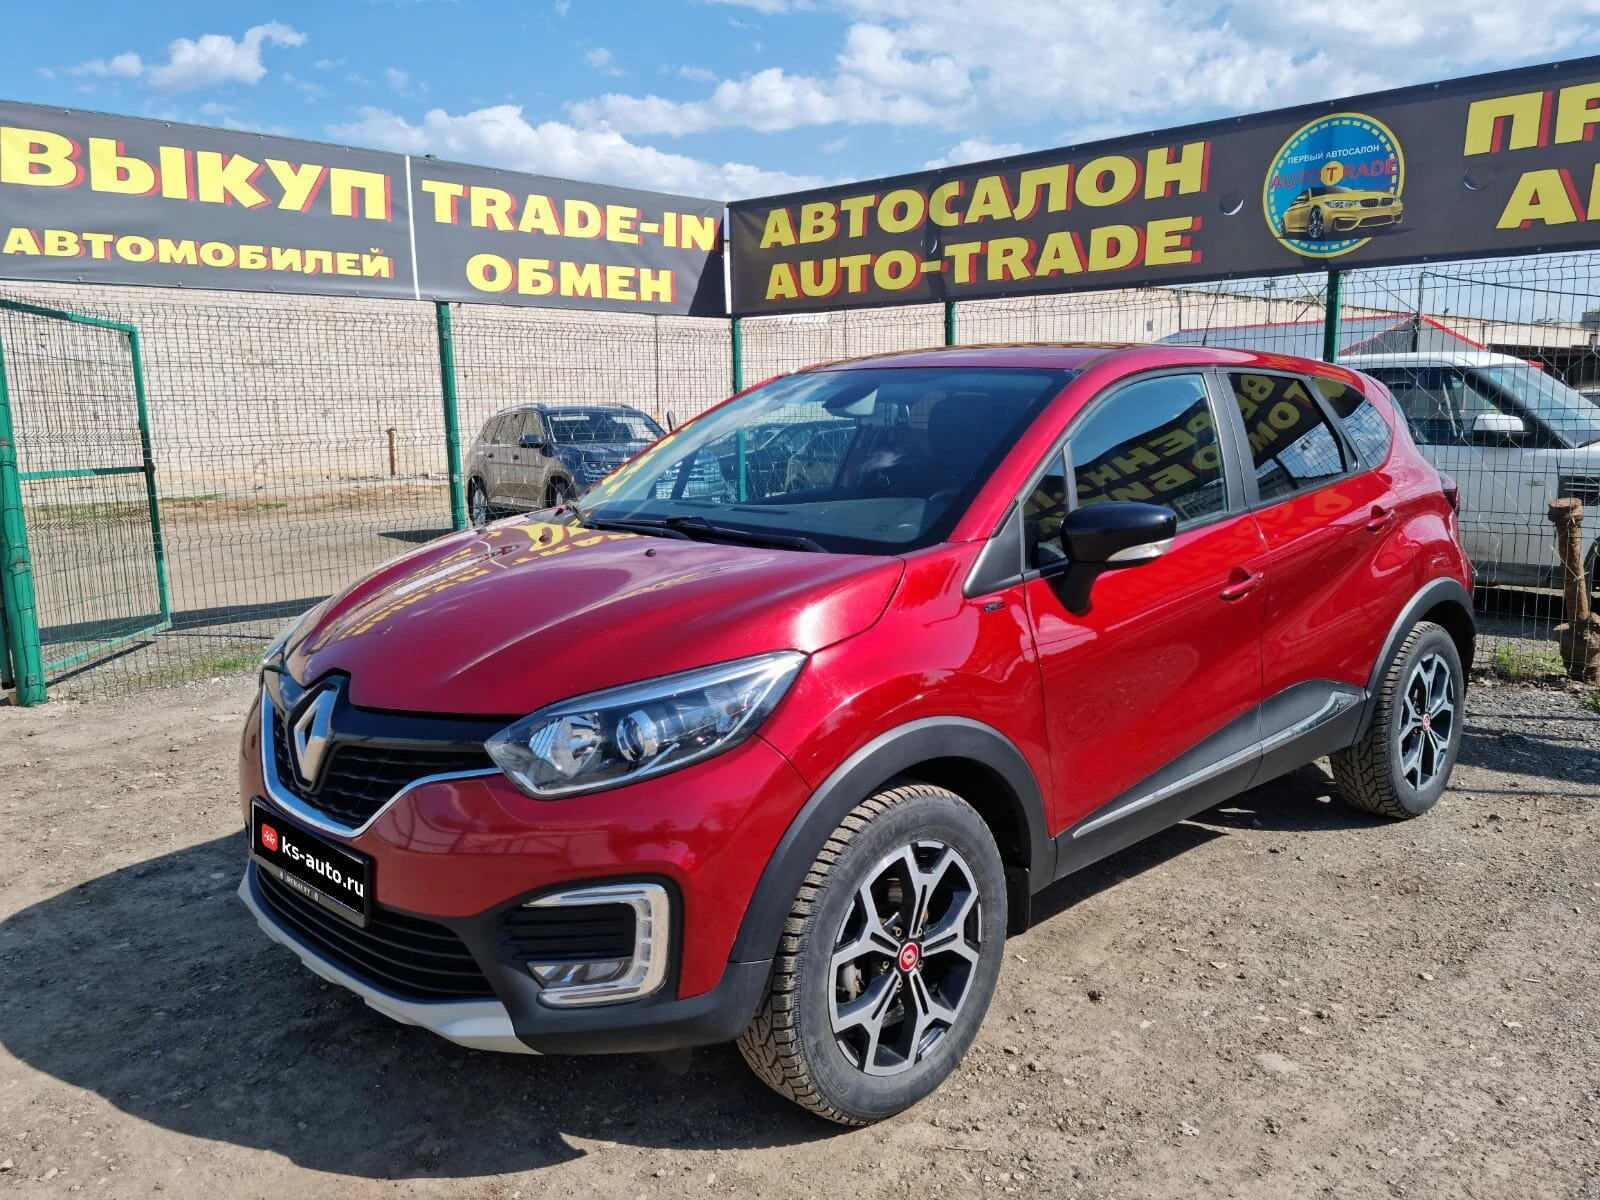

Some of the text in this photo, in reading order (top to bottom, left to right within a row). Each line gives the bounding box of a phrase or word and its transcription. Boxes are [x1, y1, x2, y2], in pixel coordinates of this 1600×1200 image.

[0, 126, 392, 221] ВЫКУП
[1287, 144, 1380, 165] ПЕРВЫЙ АВТОСАЛОН
[421, 180, 719, 251] TRADE-IN
[759, 141, 1211, 249] АВТОСАЛОН
[1495, 162, 1600, 230] А
[2, 227, 394, 279] АВТОМОБИЛЕЙ
[465, 253, 676, 303] ОБМЕН
[765, 216, 1202, 300] AUTO-TRADE
